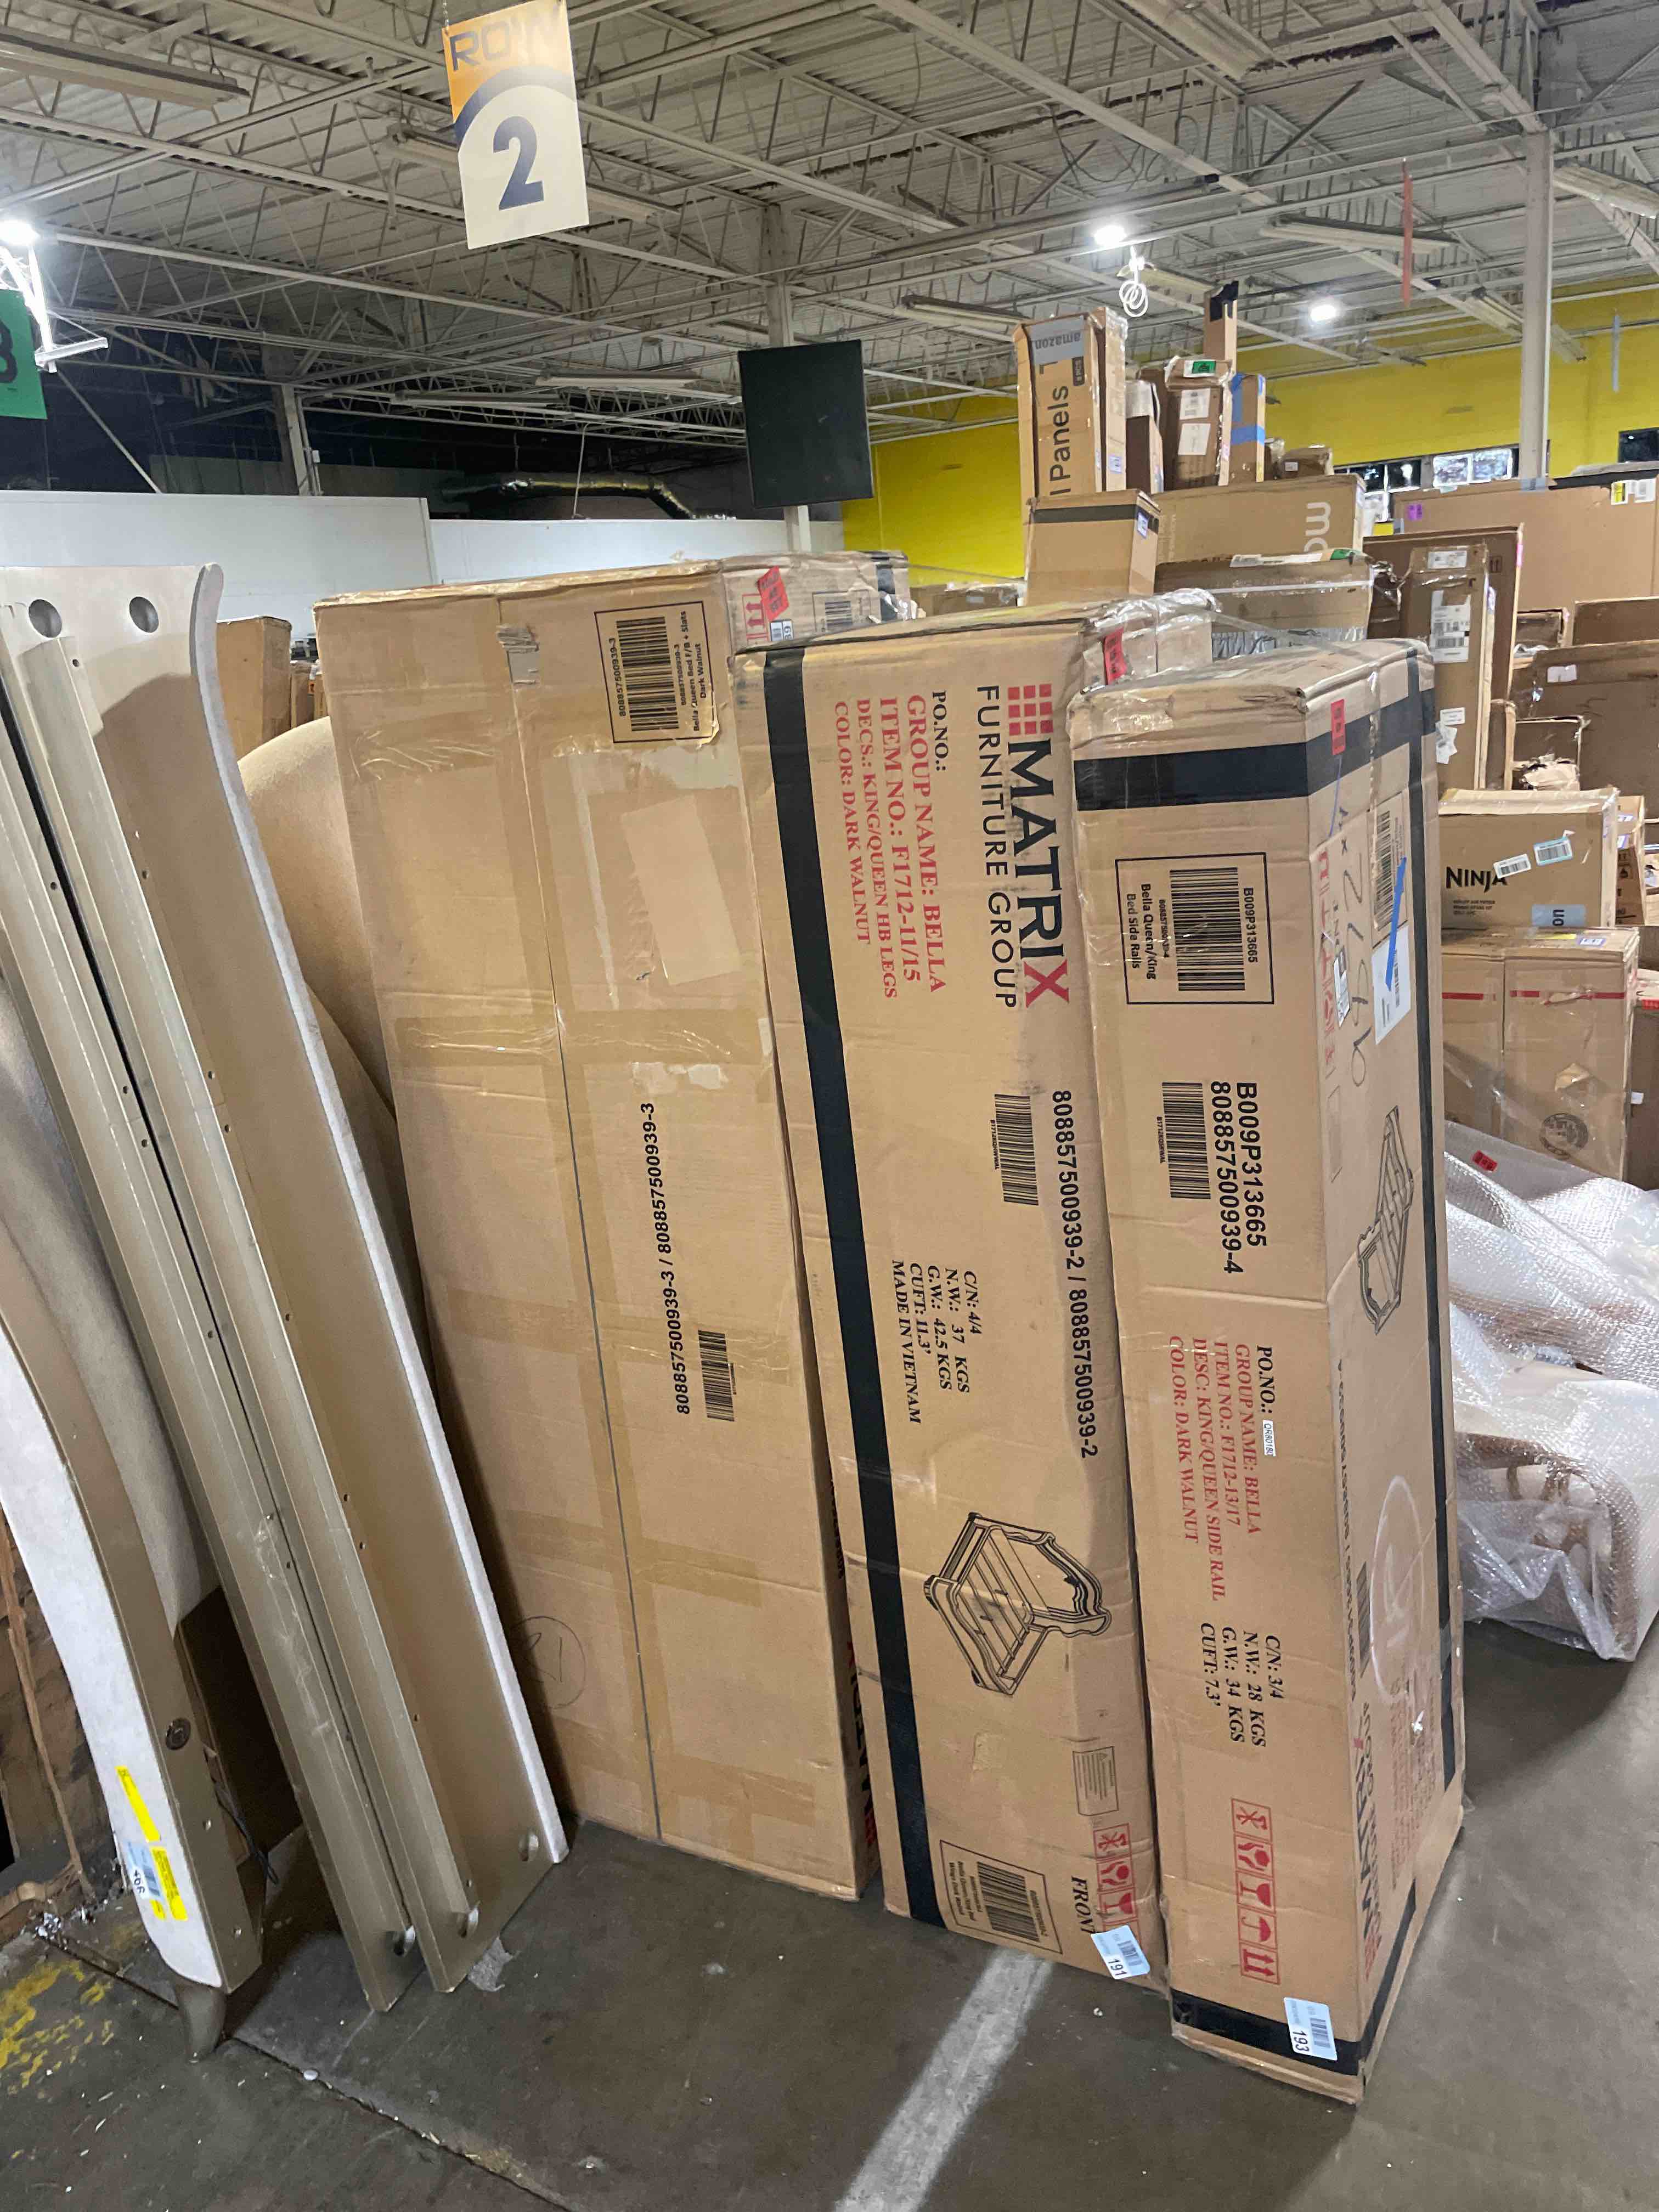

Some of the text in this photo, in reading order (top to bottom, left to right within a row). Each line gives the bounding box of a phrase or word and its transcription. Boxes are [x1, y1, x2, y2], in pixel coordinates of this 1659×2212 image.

[494, 116, 544, 211] 2
[1047, 386, 1071, 482] Panels
[695, 644, 704, 675] Walnut
[933, 690, 949, 772] PO.NO.:
[834, 701, 871, 945] COLOR: DARK WALNUT
[856, 698, 897, 998] DECS.: KING/QUEEN HB LEGS
[879, 697, 921, 982] ITEM NO.: F1712-11/15
[907, 695, 946, 992] GROUP NAME: BELLA
[977, 685, 1017, 1008] FURNITURE GROUP
[1007, 738, 1070, 1008] MATRIX
[1126, 894, 1138, 915] Bed
[1128, 918, 1140, 940] Side
[1141, 883, 1153, 911] Bella
[640, 1103, 672, 1254] 808857500939-3
[1211, 1081, 1244, 1274] 808857500939-4
[1237, 1082, 1267, 1246] B009P313665
[910, 1263, 926, 1315] CUFT:
[928, 1265, 952, 1390] G.W.: 42.5 KGS
[945, 1268, 969, 1393] N.W.: 37 KGS
[964, 1271, 983, 1335] C/N: 4/4
[1052, 1090, 1085, 1270] 808857500939-2
[1069, 1289, 1098, 1459] 808857500939-2
[661, 1271, 690, 1414] 808857500939-3
[892, 1260, 921, 1424] MADE IN VIETNAM
[1193, 1338, 1210, 1391] DESC:
[1257, 1345, 1276, 1414] PO.NO.:
[1170, 1336, 1199, 1544] COLOR: DARK WALNUT
[1197, 1397, 1219, 1510] KING/QUEEN
[1214, 1342, 1241, 1527] ITEM NO.: F1712-13/17
[1235, 1345, 1261, 1534] GROUP NAME: BELLA
[1206, 1515, 1223, 1555] SIDE
[1200, 1622, 1218, 1674] CUFT:
[1222, 1627, 1245, 1742] G.W.: 34 KGS
[1243, 1630, 1266, 1747] N.W.: 28 KGS
[1265, 1635, 1285, 1699] C/N: 3/4
[1108, 1959, 1127, 1976] 191
[1293, 2030, 1310, 2052] 193
